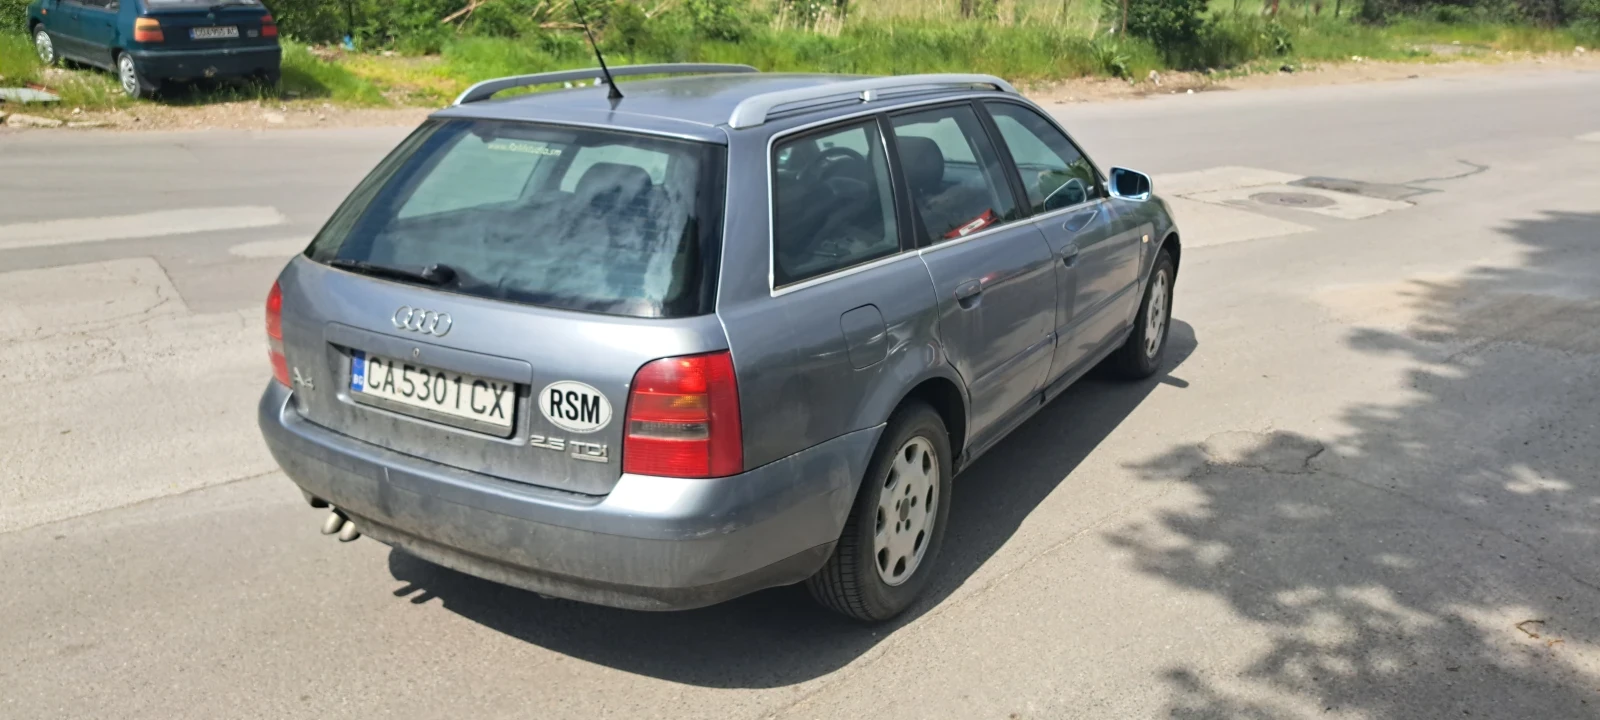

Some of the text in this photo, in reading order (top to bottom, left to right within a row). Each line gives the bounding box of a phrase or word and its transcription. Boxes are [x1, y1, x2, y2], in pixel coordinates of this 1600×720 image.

[352, 373, 364, 385] BG
[368, 356, 509, 419] CA 5301 CX
[550, 388, 600, 425] RSM
